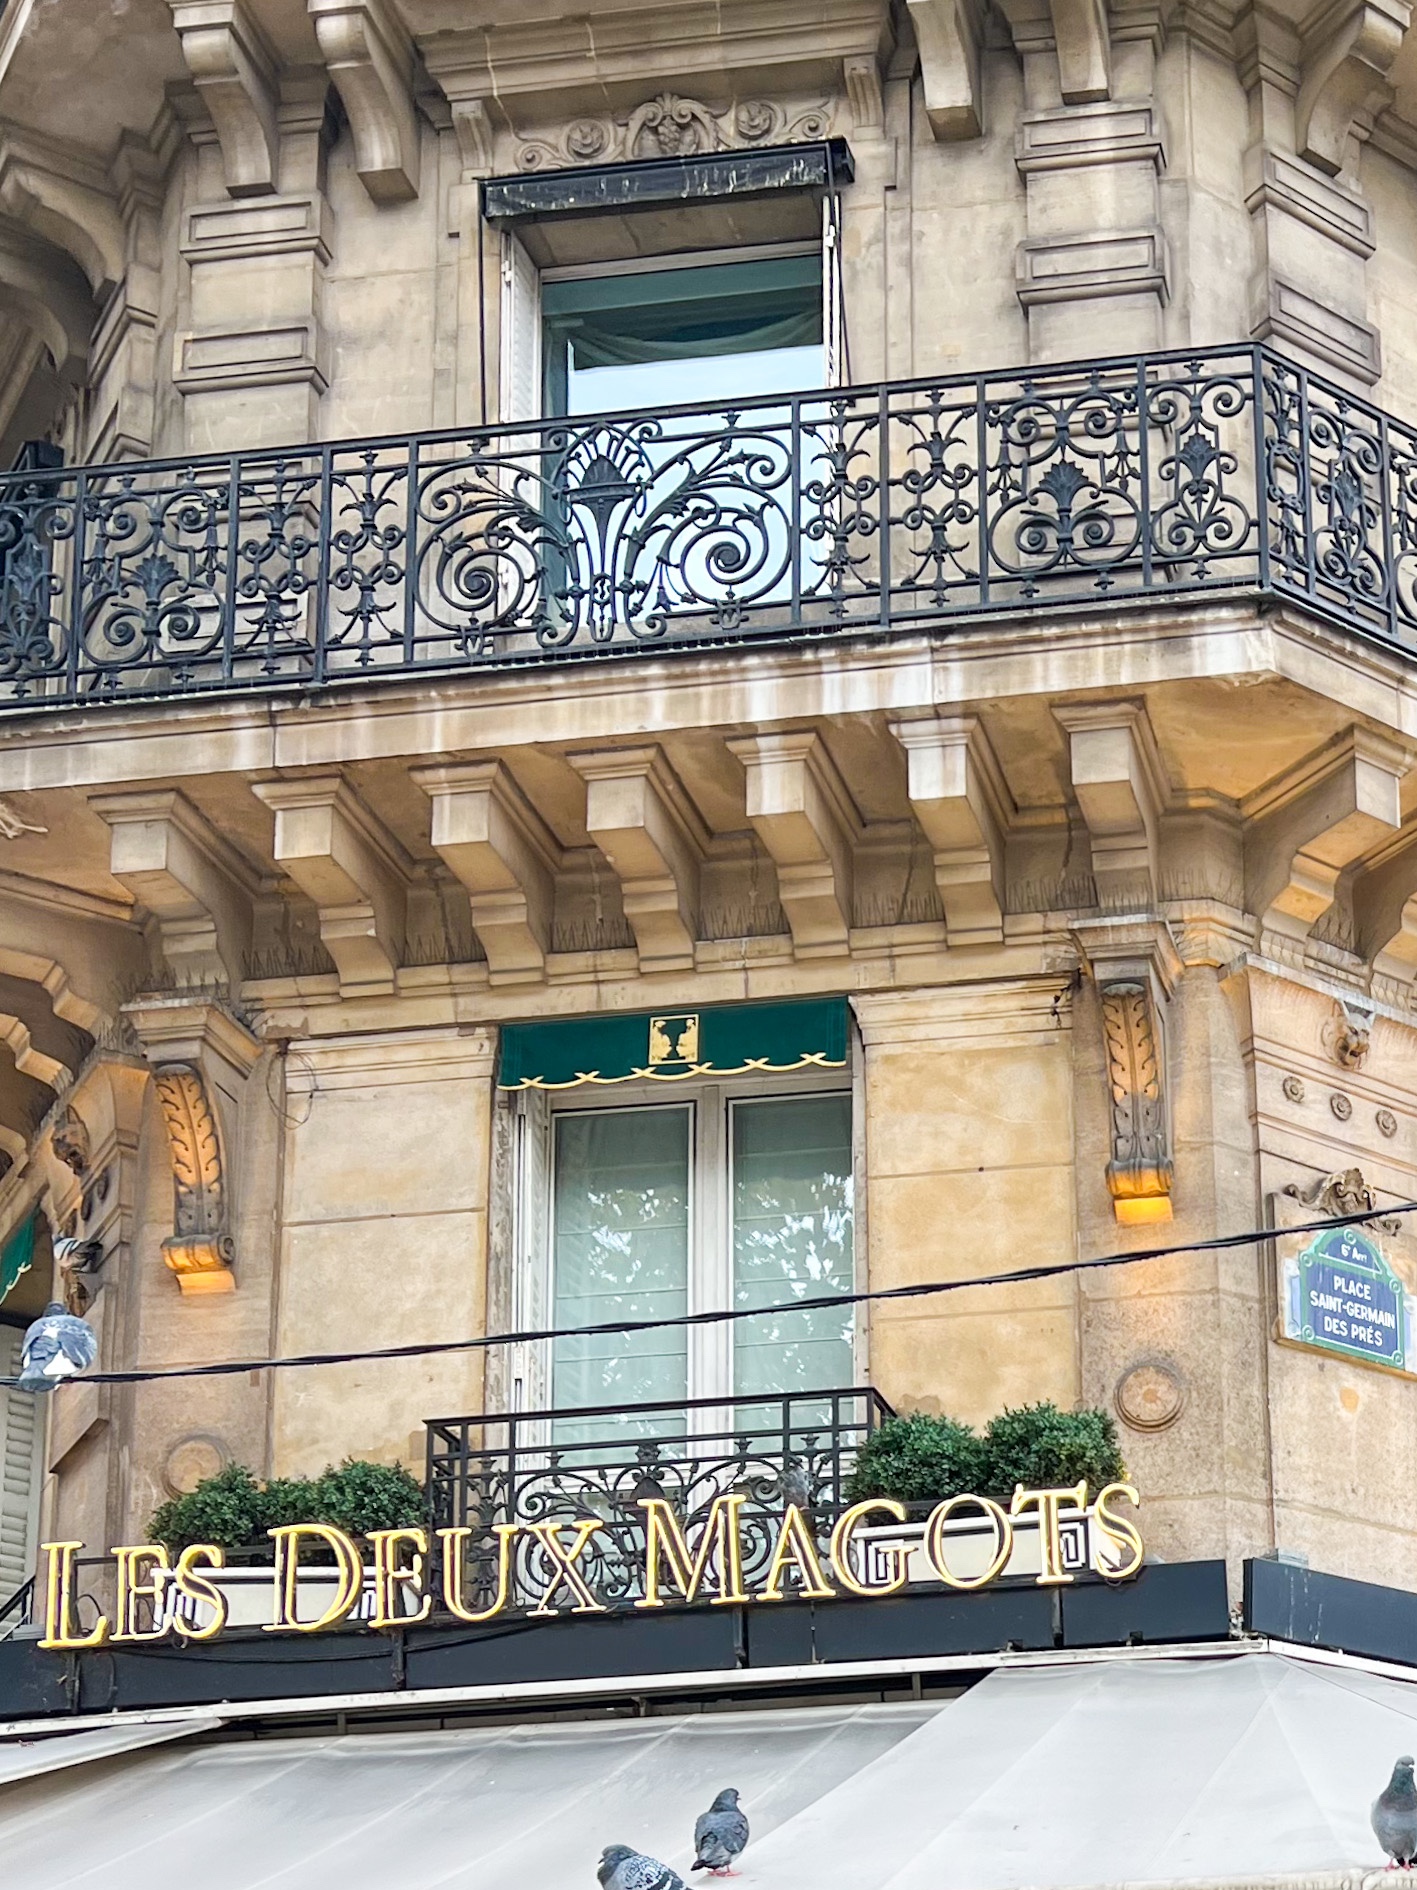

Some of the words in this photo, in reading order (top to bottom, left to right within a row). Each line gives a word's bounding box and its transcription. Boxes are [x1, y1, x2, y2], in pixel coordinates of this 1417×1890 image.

[1333, 1275, 1371, 1301] PLACE
[1309, 1291, 1396, 1329] SAINT-GERMAIN
[1323, 1316, 1348, 1337] DES
[1351, 1324, 1383, 1347] PRÉS
[37, 1540, 228, 1649] LES
[265, 1520, 607, 1631] DEUX
[635, 1481, 1144, 1607] MAGOTS
